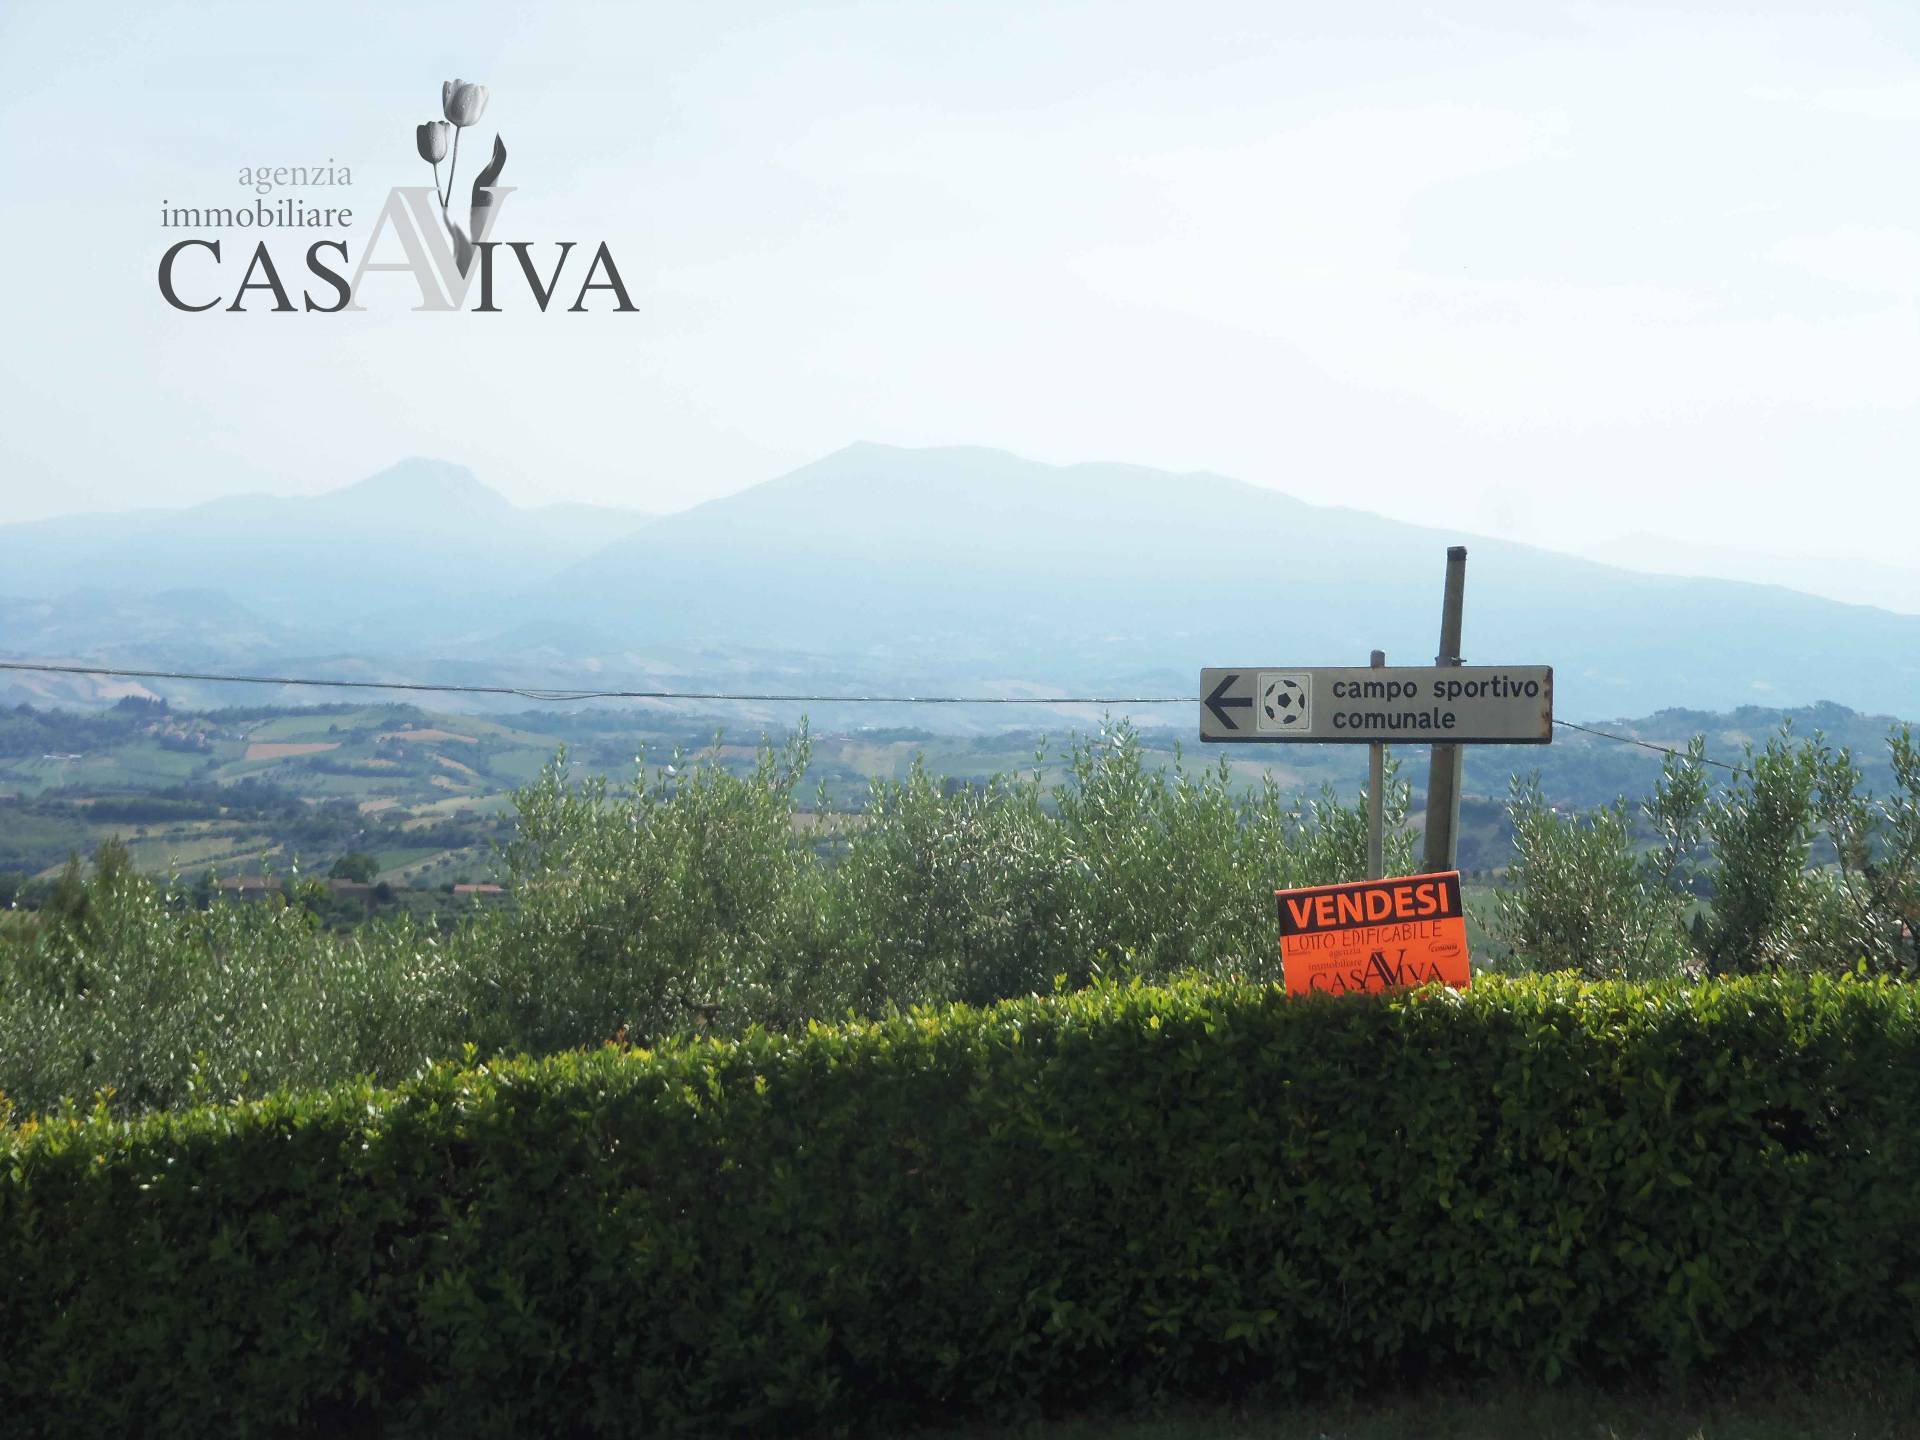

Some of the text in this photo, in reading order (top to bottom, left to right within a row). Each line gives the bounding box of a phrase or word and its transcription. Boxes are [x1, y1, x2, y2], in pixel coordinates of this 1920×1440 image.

[1332, 675, 1539, 703] campo sportivo
[1332, 707, 1456, 730] comunale
[1287, 882, 1449, 929] VENDESI
[1287, 920, 1443, 953] LOTTO EDIFICABILE
